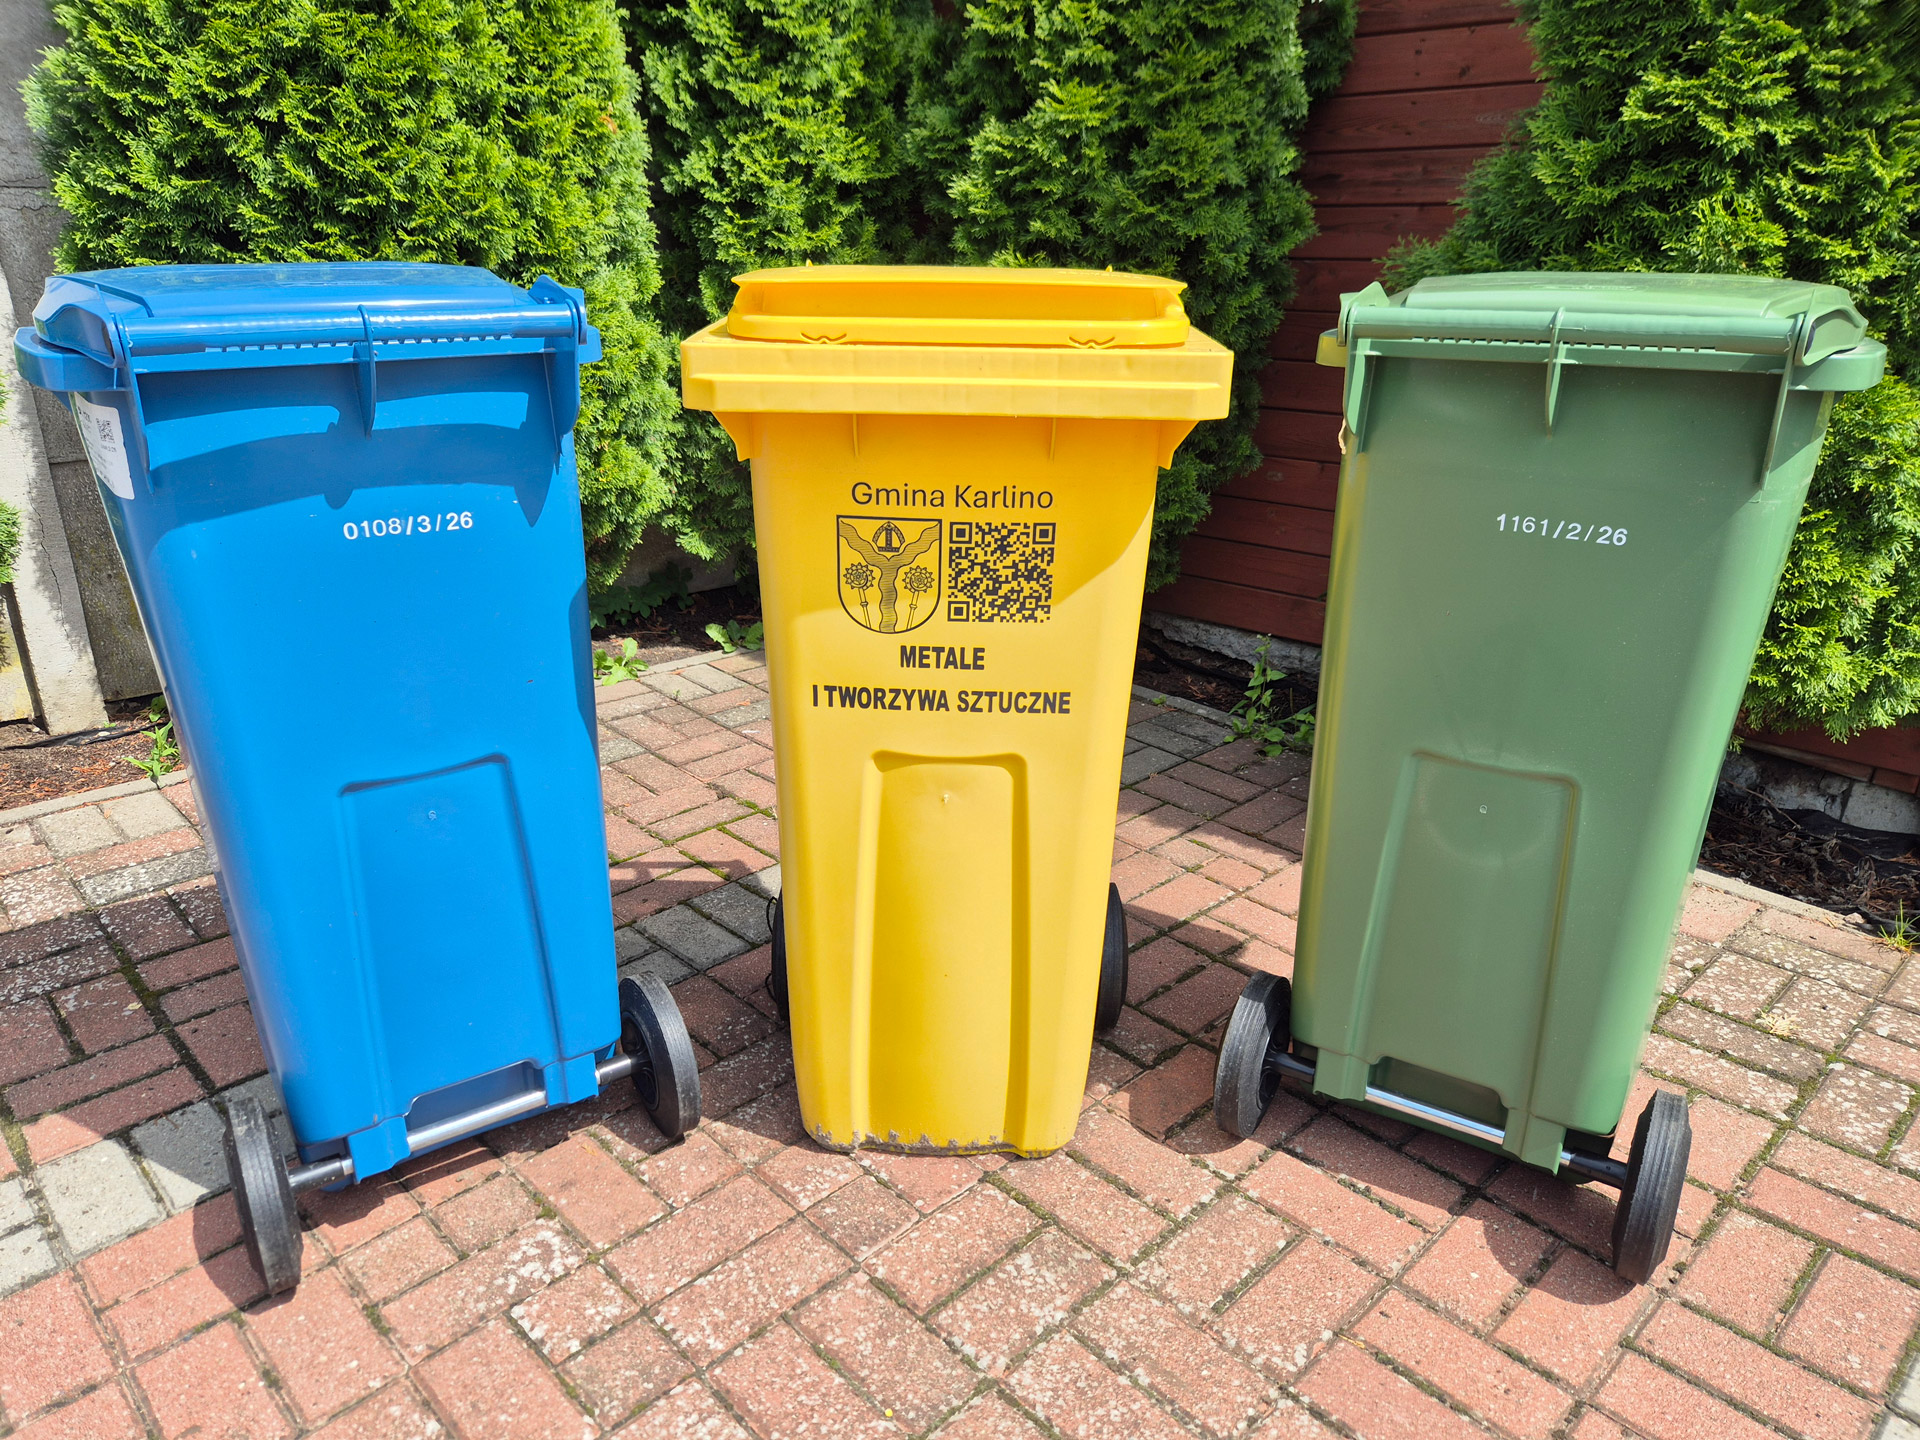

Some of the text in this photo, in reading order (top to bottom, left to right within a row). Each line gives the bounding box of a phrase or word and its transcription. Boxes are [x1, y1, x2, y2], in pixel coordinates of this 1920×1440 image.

[851, 482, 1054, 509] Gmina Karlino
[343, 511, 473, 540] 0108/3/26
[1496, 513, 1628, 546] 1161/2/26
[900, 645, 986, 670] METALE
[812, 684, 1071, 714] I TWORZYWA SZTUCZNE
